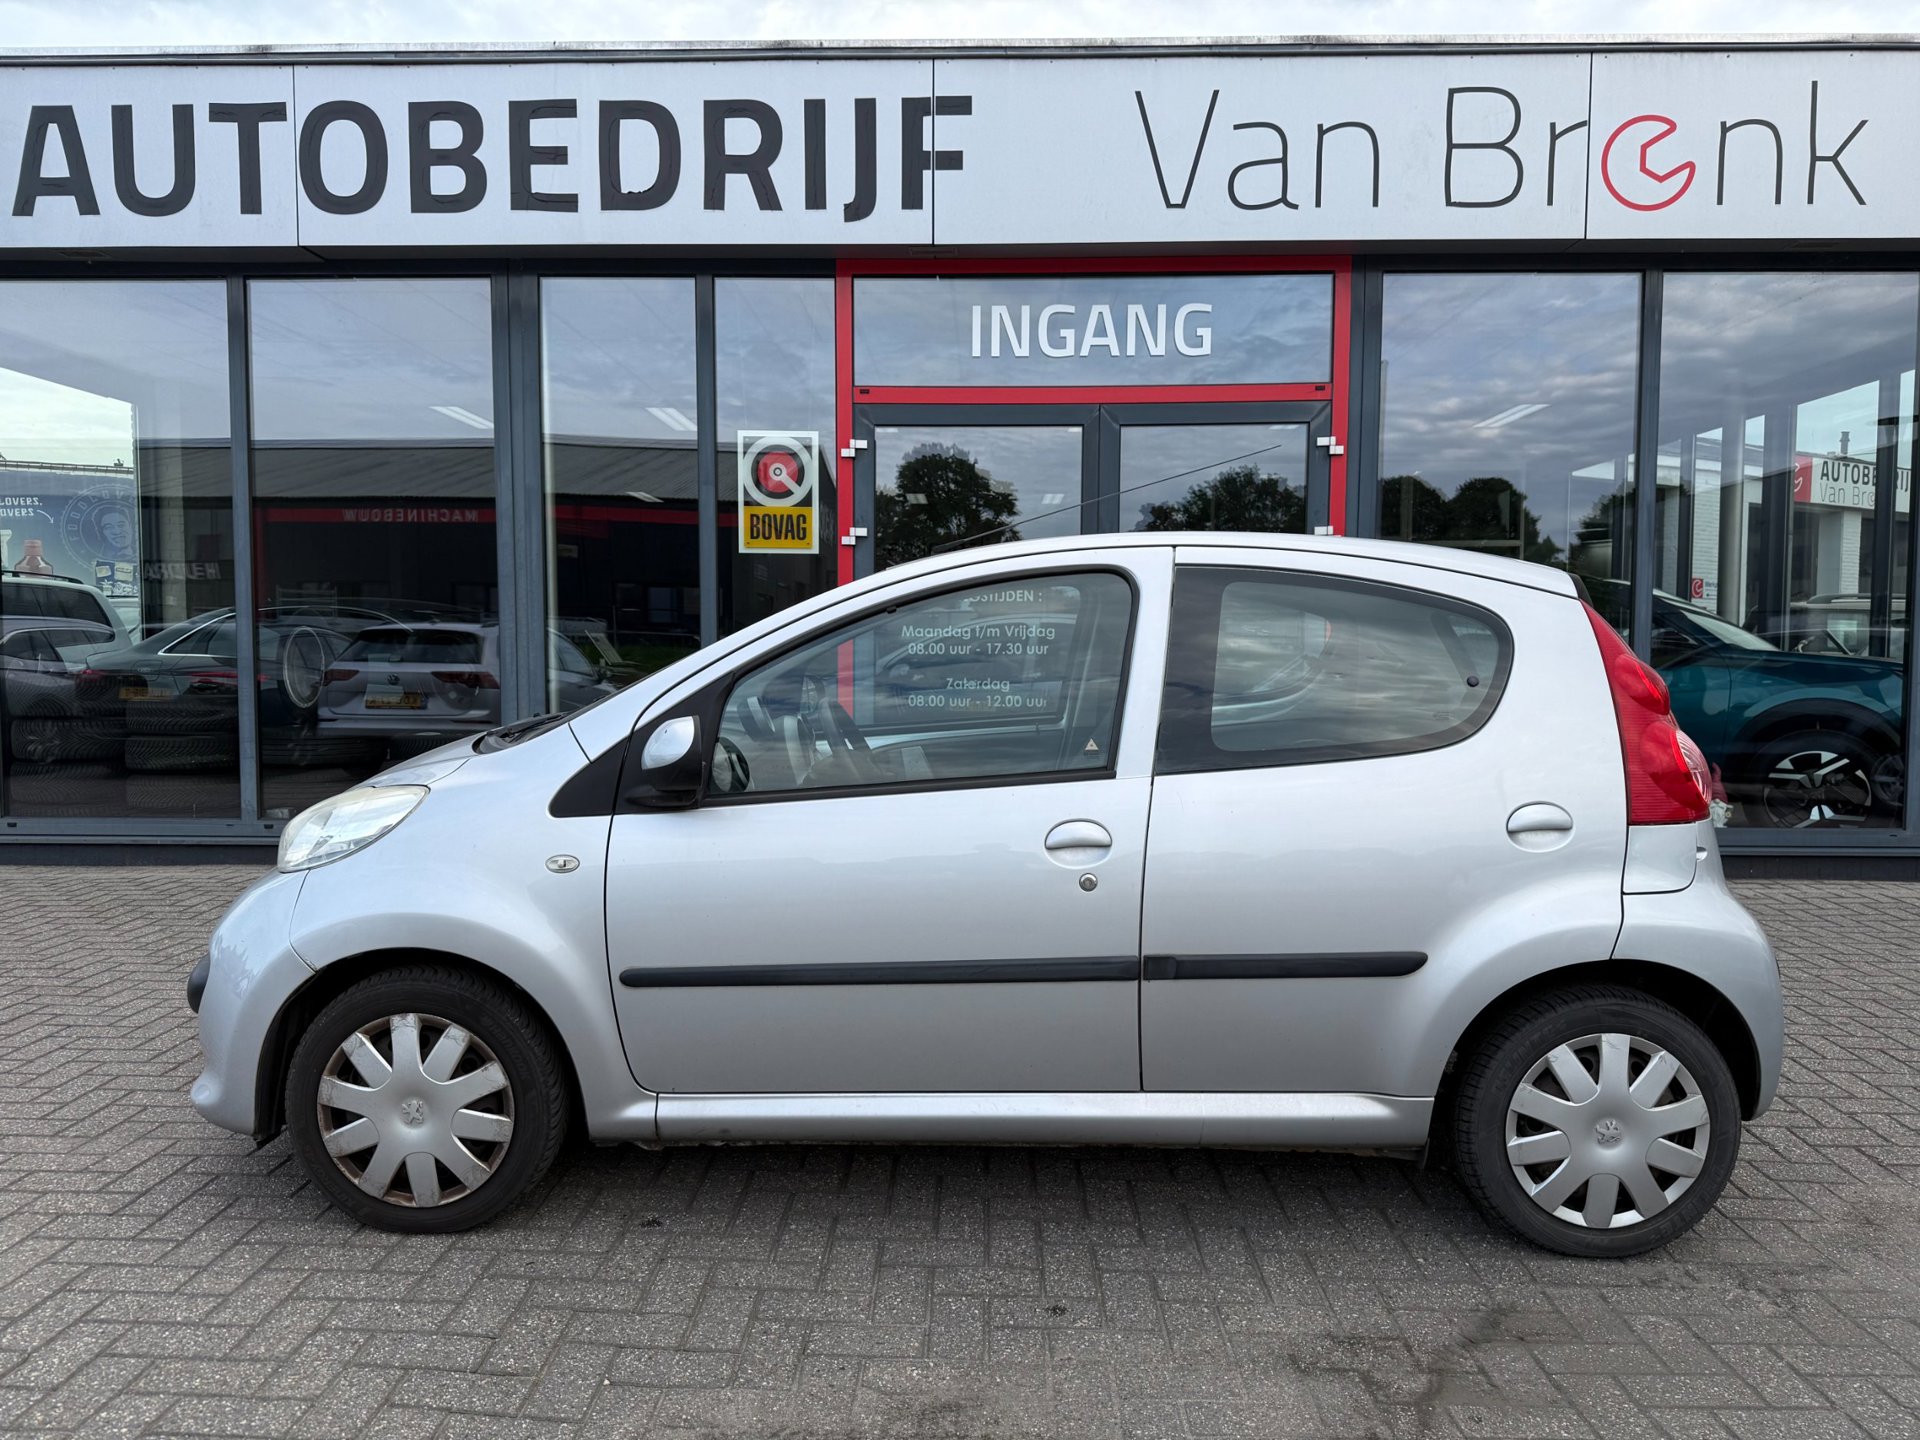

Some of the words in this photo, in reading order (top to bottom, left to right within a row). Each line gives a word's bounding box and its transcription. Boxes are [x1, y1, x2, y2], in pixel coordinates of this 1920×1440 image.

[12, 95, 973, 222] AUTOBEDRIJF
[1134, 89, 1378, 211] Van
[970, 302, 1213, 359] INGANG
[0, 508, 34, 517] OVERS
[750, 513, 807, 541] BOVAG
[901, 625, 971, 640] Maandag
[975, 625, 1000, 639] t/m
[1005, 625, 1055, 640] Vrijdag
[908, 643, 946, 655] 08.00
[950, 645, 972, 655] uur
[987, 643, 1023, 655] 17.30
[1027, 645, 1049, 655] uur
[946, 678, 1010, 692] Zaterdag
[908, 695, 946, 707] 08.00
[950, 697, 972, 707] uur
[987, 695, 1023, 707] 12.00
